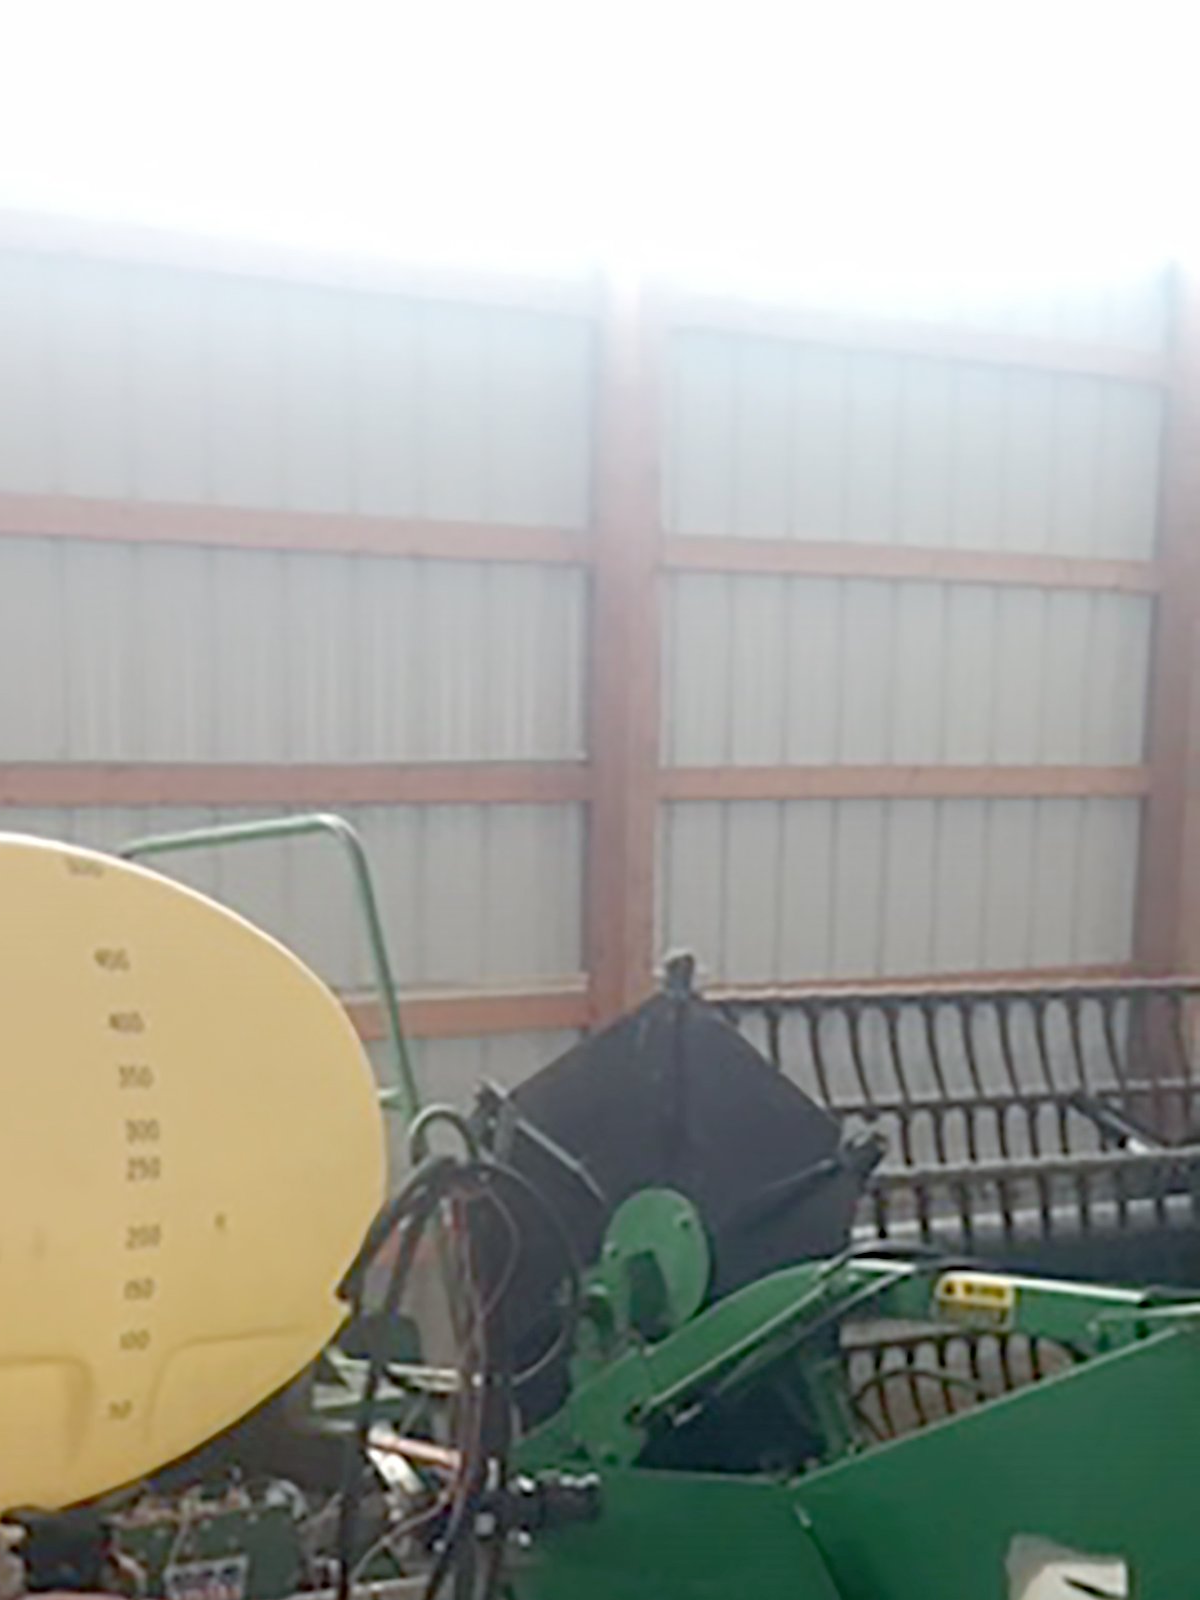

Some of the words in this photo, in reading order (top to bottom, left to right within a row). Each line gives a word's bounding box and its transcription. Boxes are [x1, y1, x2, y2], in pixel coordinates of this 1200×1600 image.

[118, 1064, 155, 1090] 350
[125, 1119, 160, 1144] 300
[126, 1156, 161, 1182] 250
[125, 1224, 161, 1250] 200
[123, 1278, 155, 1300] 150
[119, 1329, 150, 1350] 100
